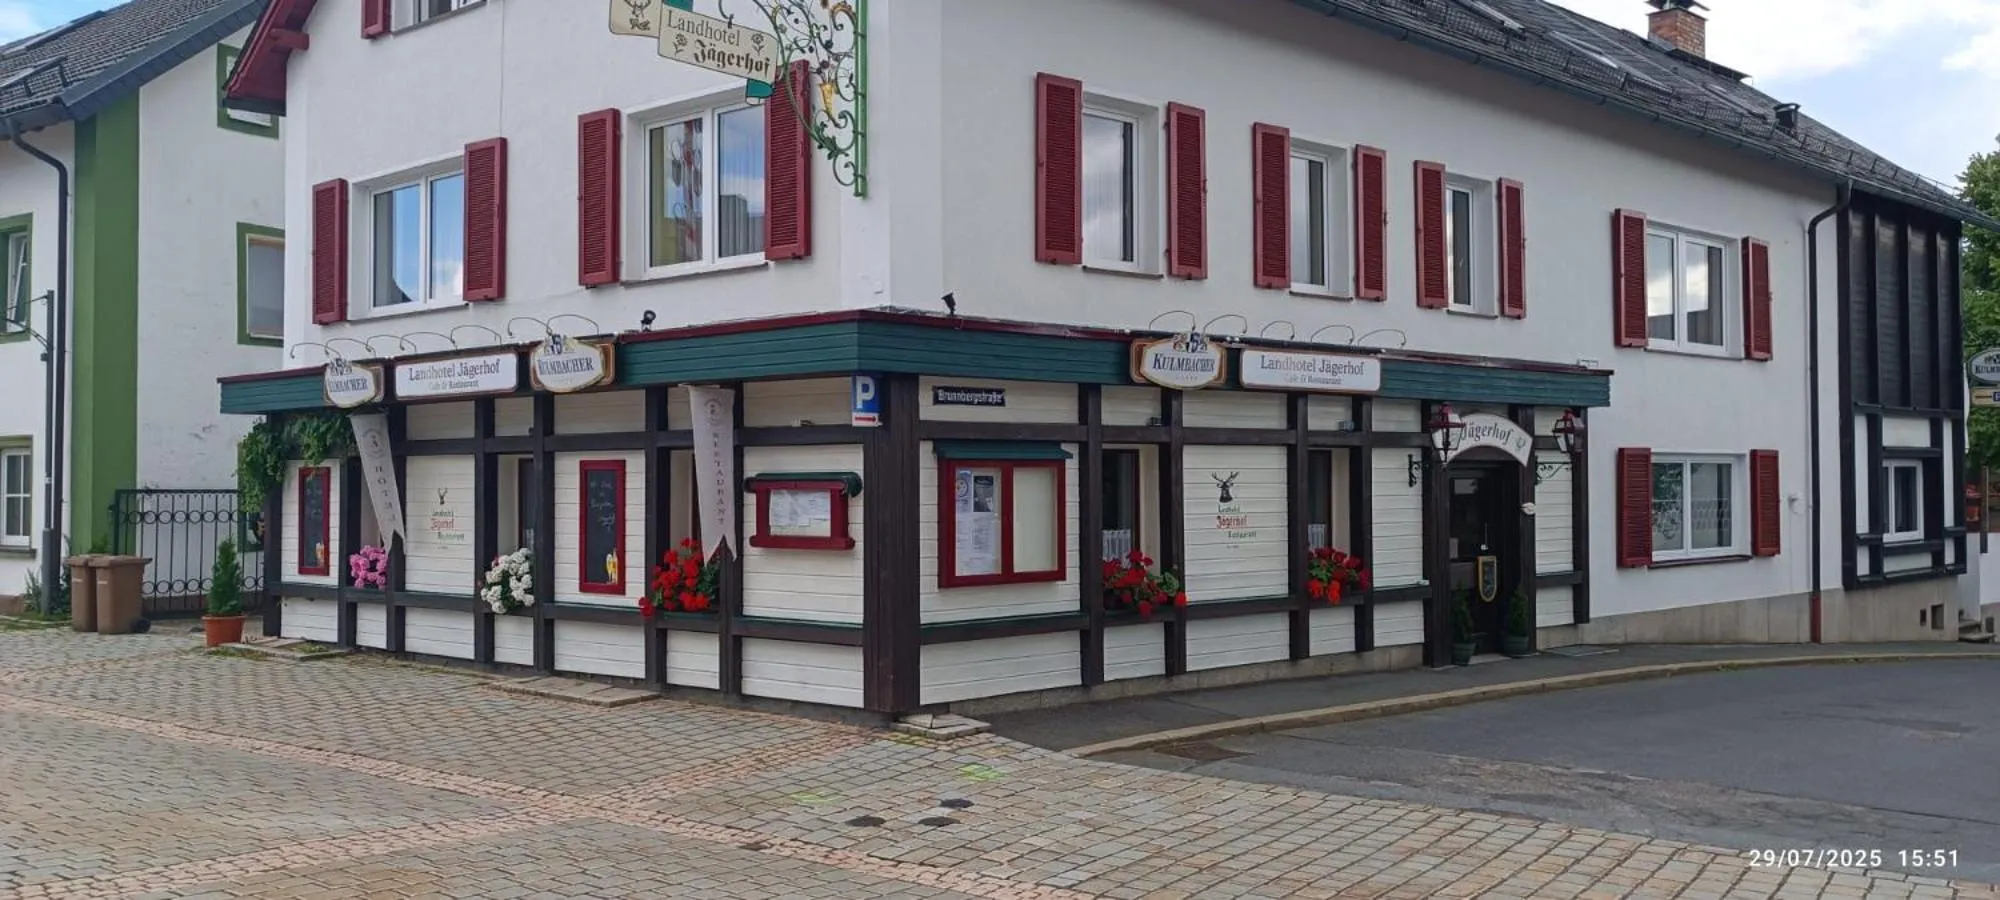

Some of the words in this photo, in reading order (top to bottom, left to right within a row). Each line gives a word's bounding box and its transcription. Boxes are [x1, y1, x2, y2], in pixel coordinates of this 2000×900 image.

[668, 10, 740, 46] Landhotel
[694, 39, 770, 77] Jägerhof
[409, 363, 455, 381] Landhotel
[457, 358, 500, 378] Jägerhof
[538, 357, 594, 375] KULMBACHER
[1152, 353, 1215, 372] KULMBACHER
[1261, 355, 1316, 372] Landhotel
[1318, 358, 1364, 376] Jägerhof
[855, 375, 876, 409] P
[1460, 420, 1514, 446] Jägerhof
